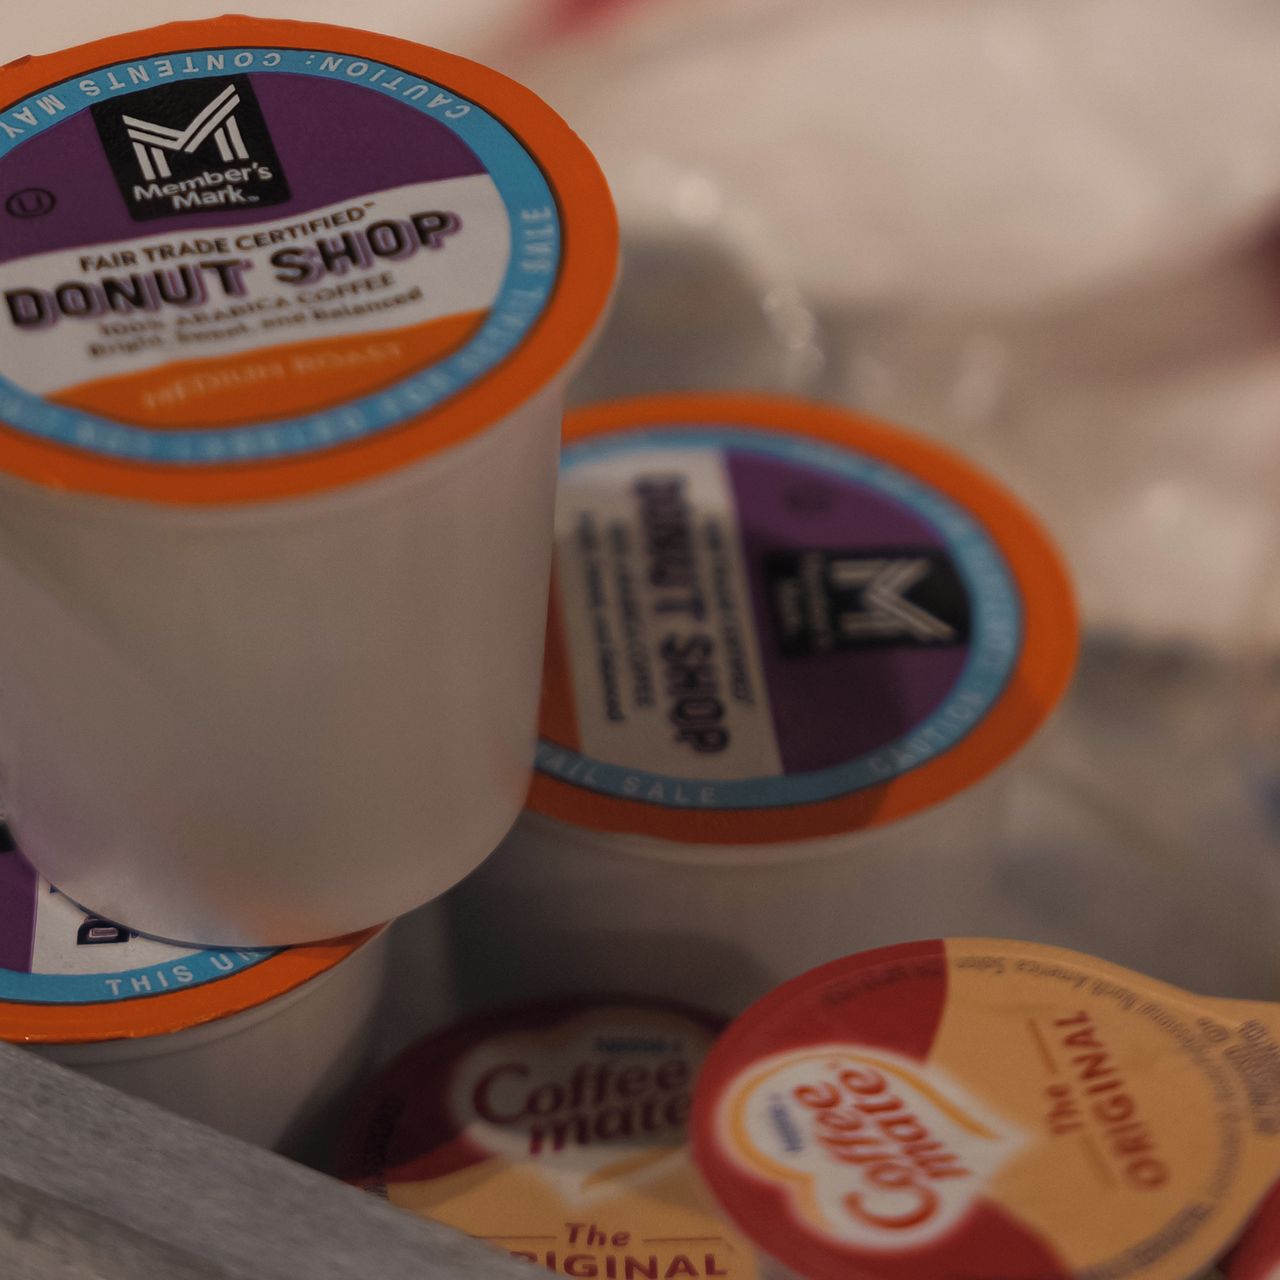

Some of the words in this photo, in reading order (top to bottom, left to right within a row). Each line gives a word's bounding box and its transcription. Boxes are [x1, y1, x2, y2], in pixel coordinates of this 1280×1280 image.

[78, 52, 282, 97] CONTENTS
[304, 53, 471, 119] CAUTION:
[132, 161, 273, 201] Member's
[79, 247, 138, 272] FAIR
[143, 236, 228, 264] TRADE
[520, 206, 556, 273] SALE
[3, 258, 254, 332] DONUT
[270, 210, 462, 286] SHOP
[175, 297, 291, 328] ARABICA
[297, 272, 395, 305] COFFEE
[313, 286, 424, 320] Balanced
[659, 631, 732, 753] SHOP
[623, 776, 718, 804] SALE
[105, 965, 193, 996] THIS
[471, 1058, 689, 1128] Coffee
[529, 1090, 694, 1157] mate
[1045, 1084, 1084, 1136] The
[1055, 1010, 1170, 1191] ORIGINAL
[839, 1069, 974, 1180] mate
[793, 1082, 939, 1231] Coffee
[564, 1221, 632, 1249] The
